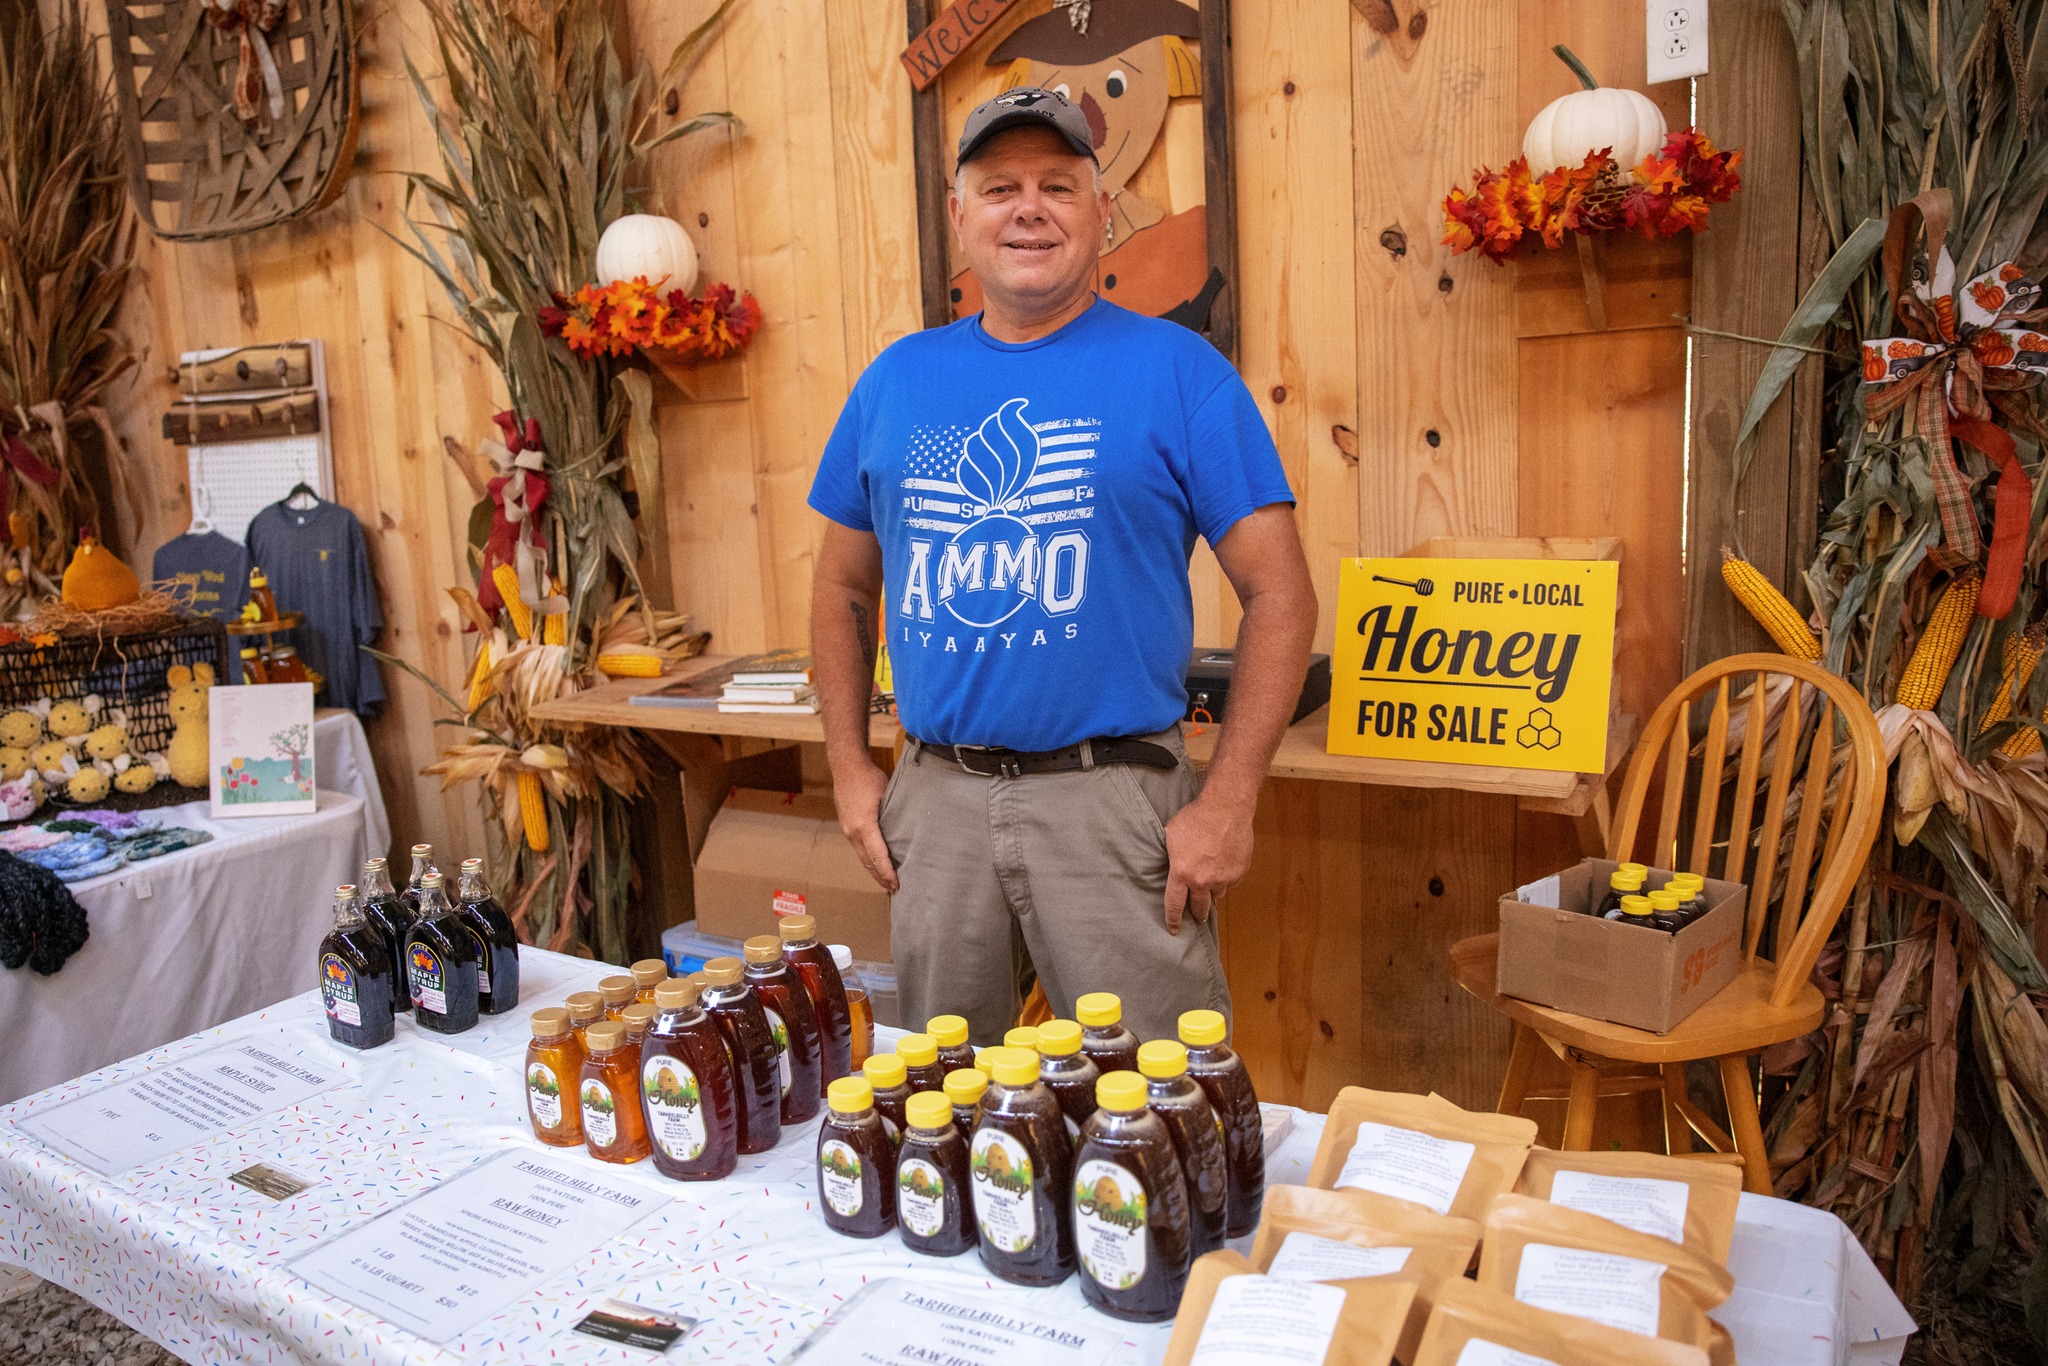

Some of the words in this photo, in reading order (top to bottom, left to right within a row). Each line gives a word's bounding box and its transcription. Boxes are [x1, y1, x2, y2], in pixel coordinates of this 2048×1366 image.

[901, 0, 1008, 81] Welc
[900, 528, 1091, 624] AMMO
[1454, 581, 1505, 604] PURE
[1523, 583, 1584, 607] LOCAL
[904, 623, 1078, 653] IYAAYAS
[1357, 605, 1582, 703] Honey
[1357, 700, 1417, 739] FOR
[1427, 704, 1508, 745] SALE
[776, 901, 804, 913] FRAGILE
[410, 967, 440, 983] MAPLE
[411, 975, 440, 989] SYRUP
[324, 978, 353, 994] MAPLE
[325, 986, 353, 1001] SYRUP
[241, 1045, 302, 1073] TARHEELBILLY
[298, 1069, 326, 1085] FARM
[219, 1065, 250, 1080] MAPLE
[245, 1077, 276, 1092] SYRUP
[648, 1090, 697, 1114] Honey
[144, 1132, 163, 1142] $15
[518, 1160, 606, 1194] TARHEELBILLY
[603, 1190, 642, 1207] FARM
[974, 1166, 1030, 1200] Honey
[549, 1200, 567, 1210] PURE
[553, 1189, 586, 1204] NATURAL
[493, 1197, 527, 1212] RAW
[522, 1205, 569, 1227] HONEY
[1079, 1199, 1143, 1236] Honey
[379, 1250, 395, 1260] LB
[369, 1266, 384, 1276] LB
[456, 1284, 478, 1297] $12
[436, 1296, 458, 1309] $30
[903, 1291, 1041, 1331] TARHEELBILLY
[1029, 1325, 1086, 1348] FARM
[967, 1328, 1016, 1346] NATURAL
[900, 1344, 947, 1362] RAW
